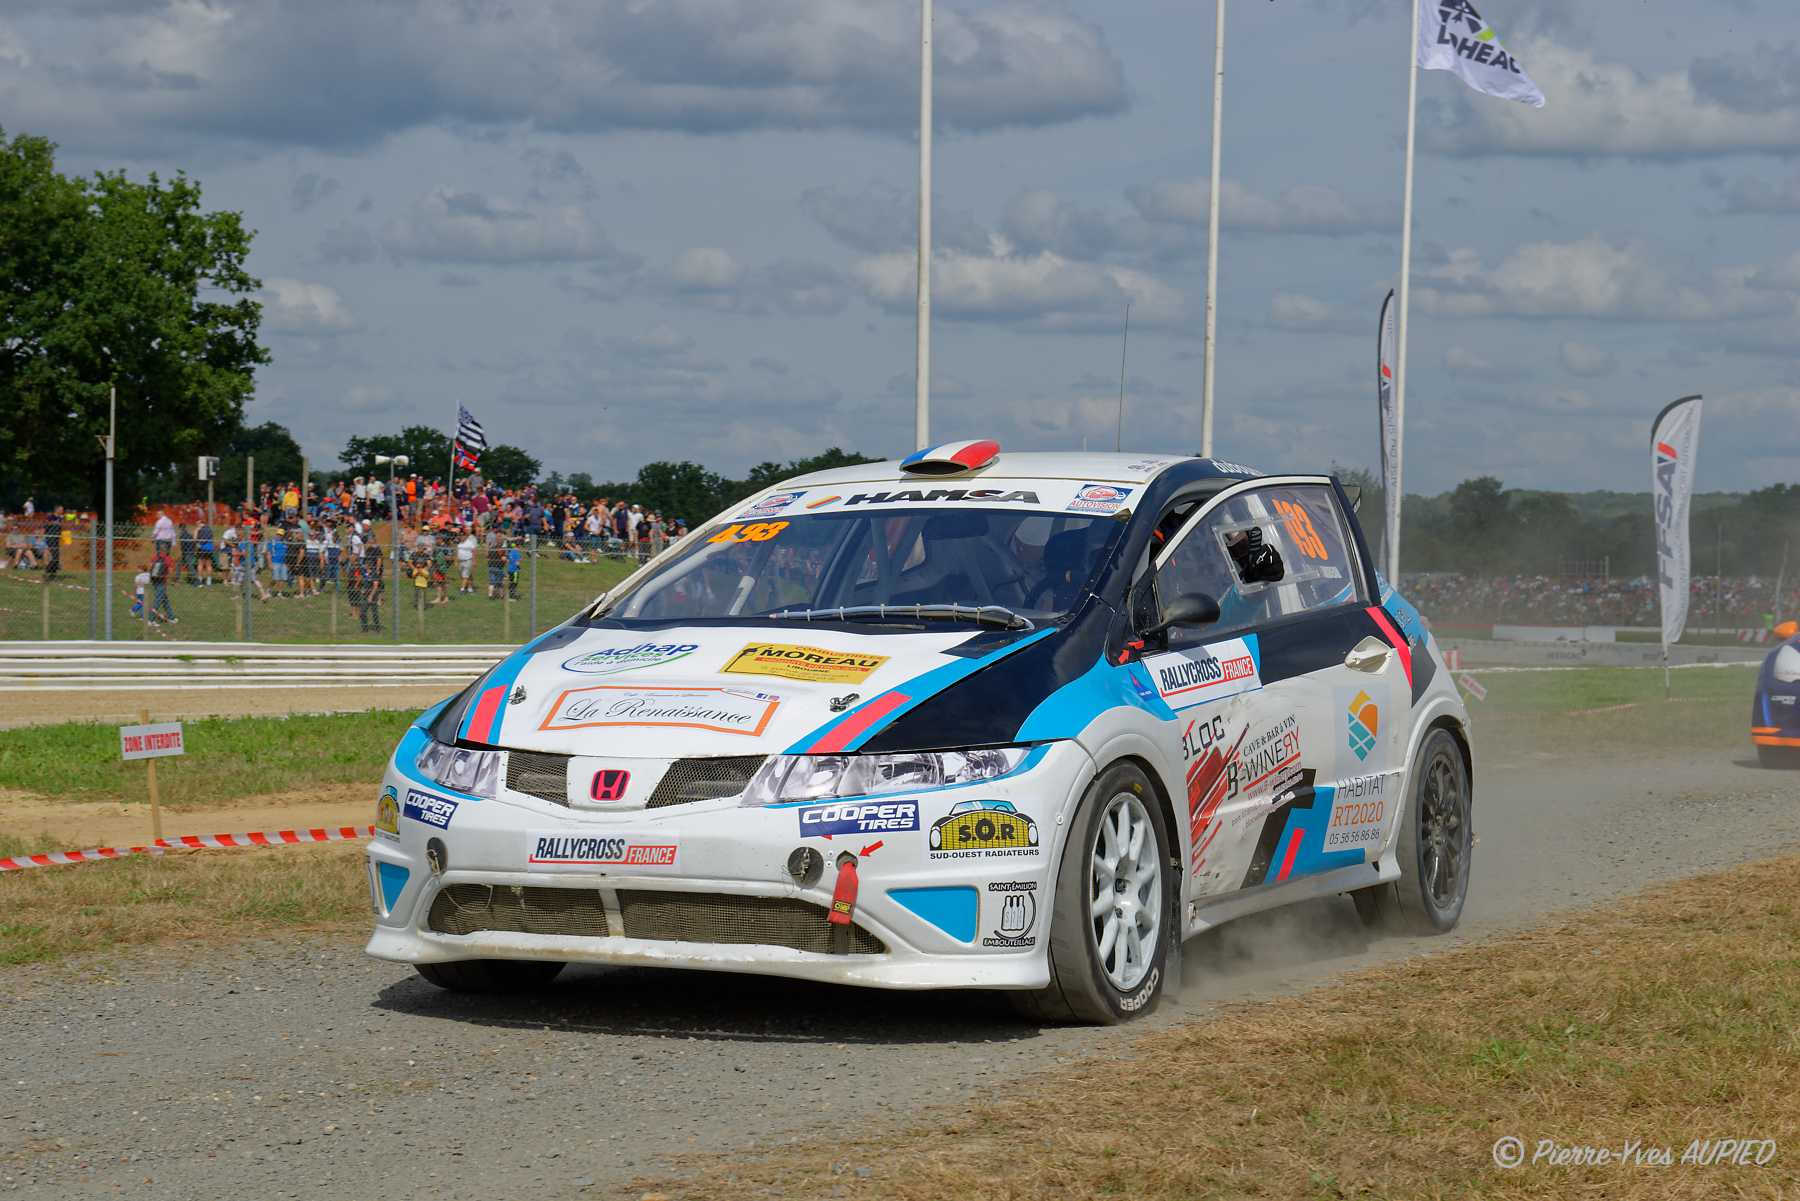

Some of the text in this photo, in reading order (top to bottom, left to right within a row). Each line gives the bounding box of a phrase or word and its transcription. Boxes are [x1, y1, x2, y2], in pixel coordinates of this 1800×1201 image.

[844, 489, 1041, 506] HAMSA
[706, 521, 791, 543] 493
[760, 647, 879, 667] MOREAU
[1160, 656, 1253, 691] RALLYCROSS FRANCE
[560, 697, 752, 725] La Renaissance
[124, 732, 180, 752] ZONE INTERDITE
[1336, 774, 1385, 799] HABITAT
[406, 792, 456, 816] COOPER
[802, 803, 916, 824] COOPER
[1331, 801, 1384, 827] RT2020
[420, 810, 449, 826] TIRES
[857, 818, 914, 831] TIRES
[535, 837, 672, 864] RALLYCROSS FRANCE
[930, 848, 1040, 860] SUD-OUEST RADIATEURS
[1120, 967, 1160, 1012] COOPER
